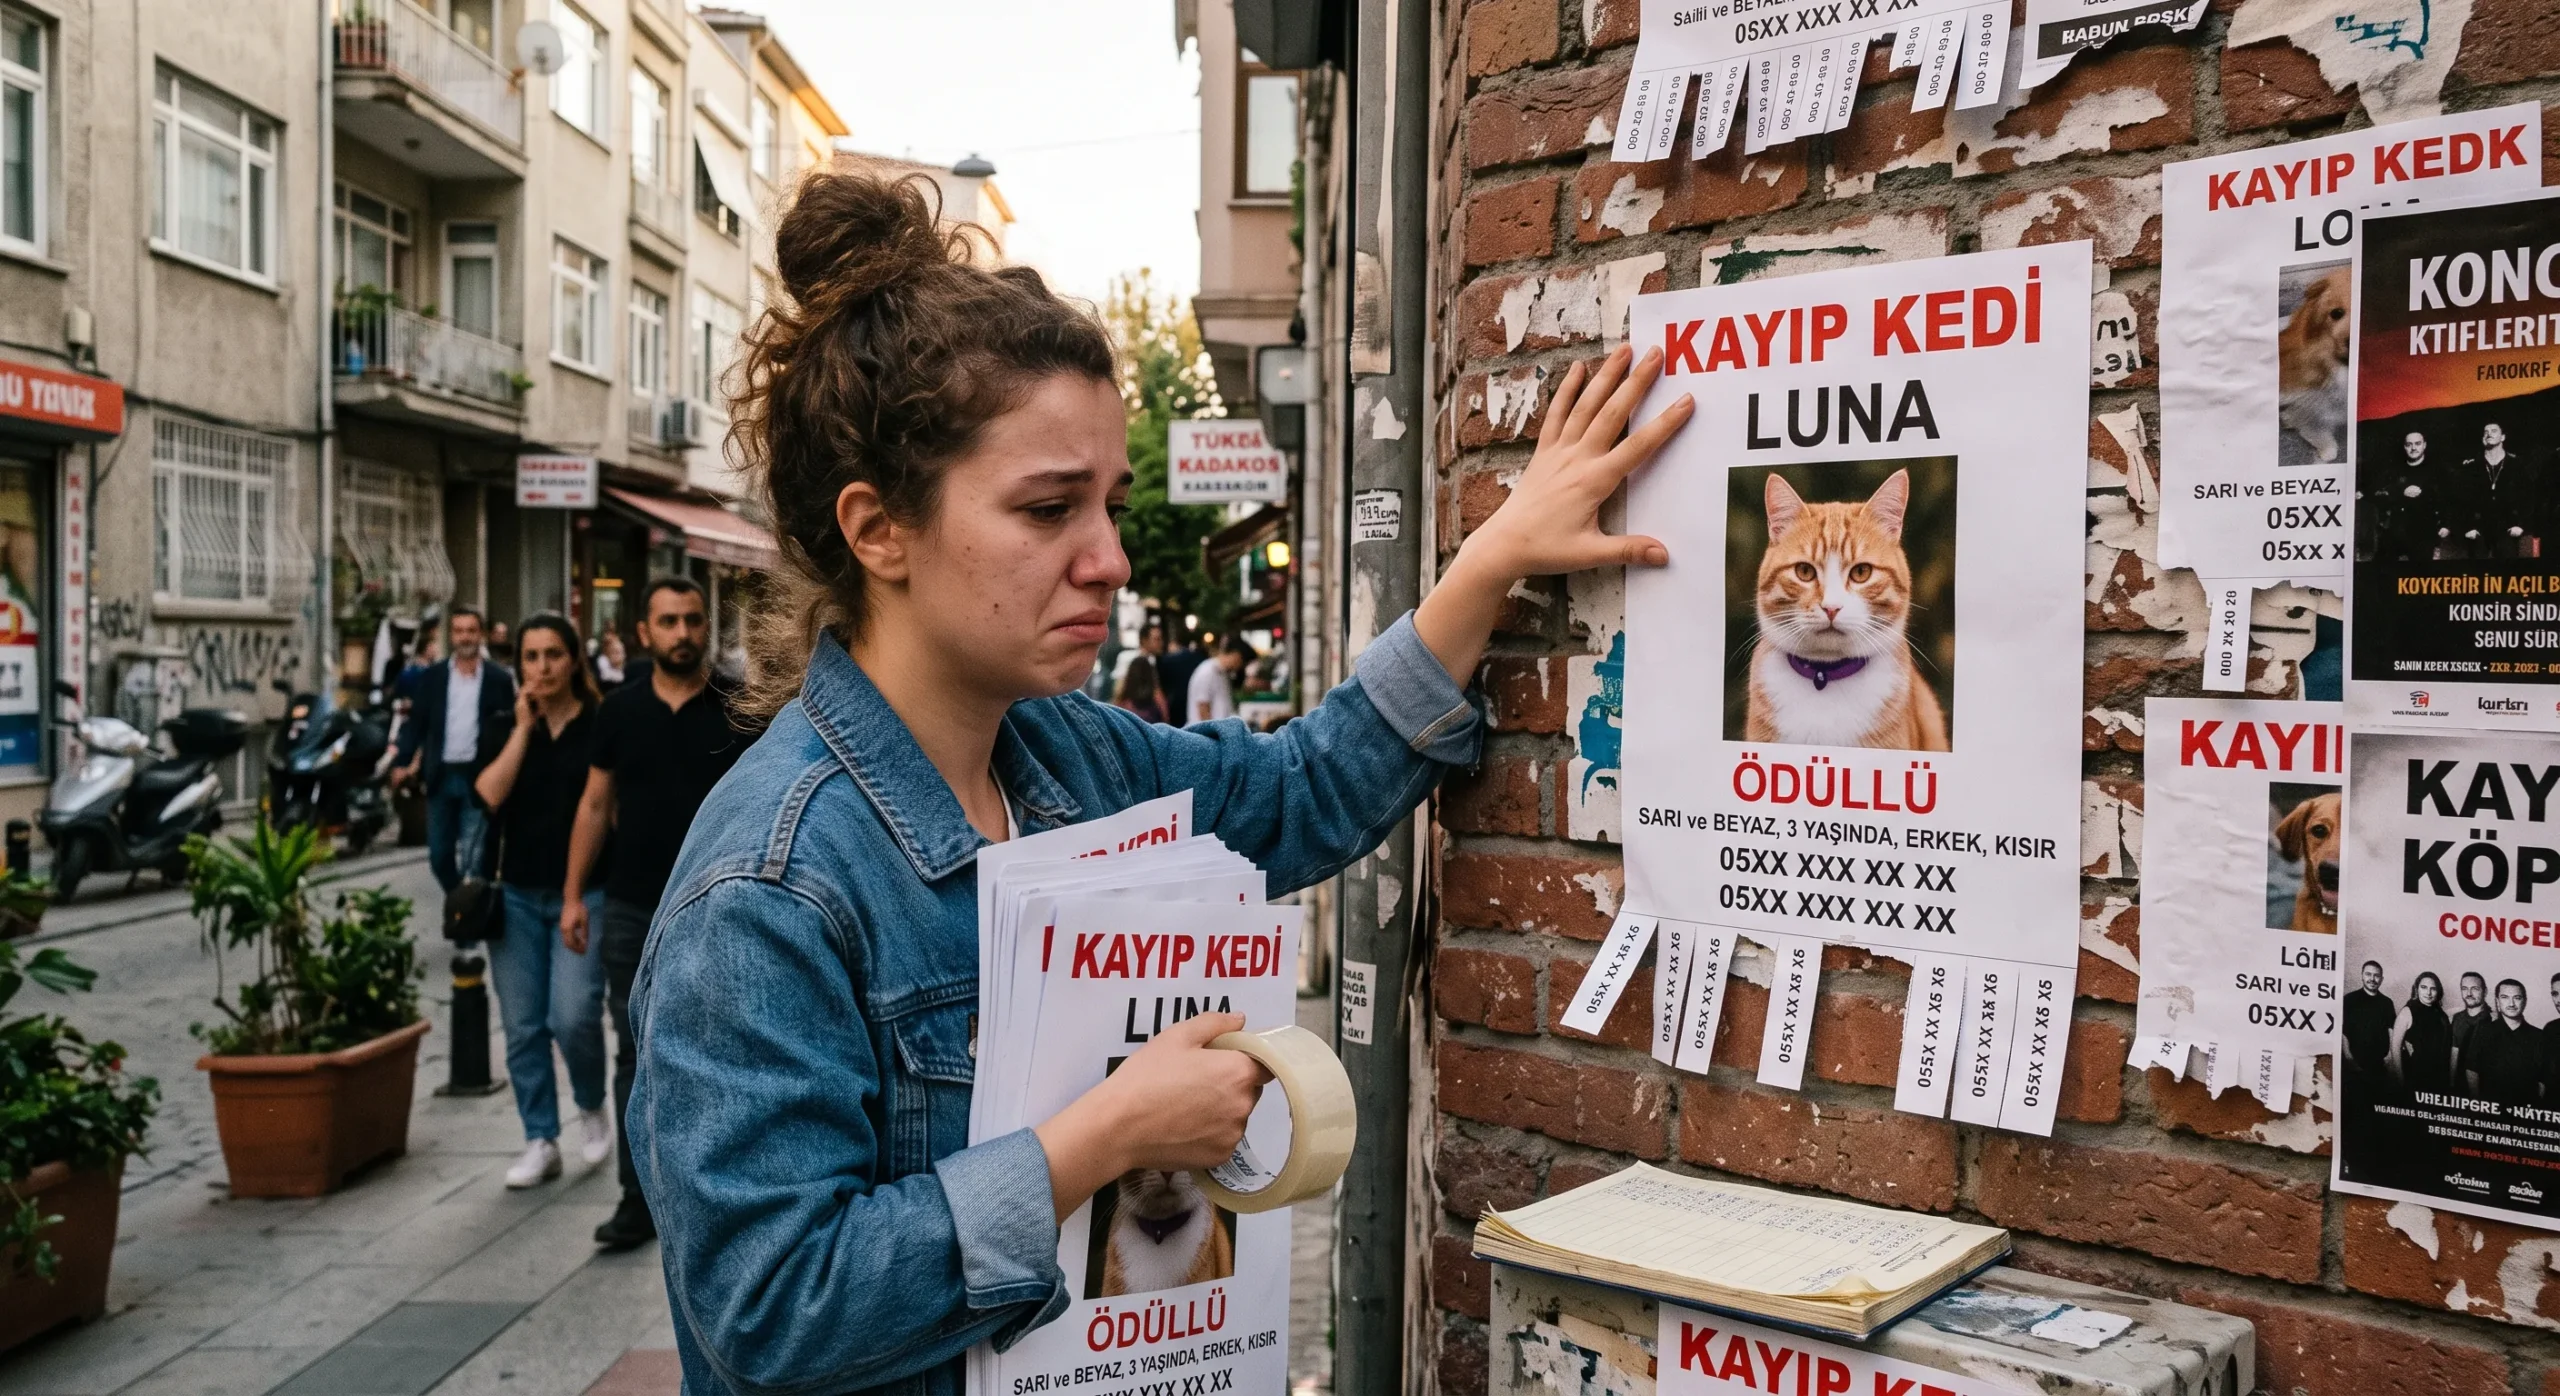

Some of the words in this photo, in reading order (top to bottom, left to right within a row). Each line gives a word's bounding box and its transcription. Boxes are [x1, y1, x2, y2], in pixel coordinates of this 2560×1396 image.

[1712, 5, 1728, 19] ve
[1795, 2, 1842, 32] XXX
[2208, 153, 2355, 212] KAYIP
[2374, 124, 2528, 184] KEDK
[1664, 303, 1849, 376] KAYIP
[1873, 265, 2042, 357] KEDİ
[1746, 379, 1941, 451] LUNA
[2194, 483, 2238, 499] SARI
[2244, 484, 2265, 497] ve
[2271, 478, 2341, 496] BEYAZ,
[2267, 504, 2342, 529] 05XX
[2507, 575, 2545, 597] AÇIL
[2524, 629, 2560, 648] SÜR
[2180, 719, 2343, 774] KAYI
[1733, 752, 1938, 815] ÖDÜLLÜ
[1638, 807, 1682, 829] SARI
[1687, 814, 1707, 830] ve
[1713, 812, 1781, 839] BEYAZ,
[1787, 818, 1797, 838] 3
[1803, 820, 1899, 850] YAŞINDA,
[1905, 828, 1987, 857] ERKEK,
[1995, 834, 2057, 860] KISIR
[1720, 846, 1789, 877] 05XX
[1796, 853, 1856, 883] XXX
[1864, 859, 1905, 888] XX
[1914, 864, 1957, 894] XX
[1719, 884, 1789, 916] 05XX
[1796, 892, 1856, 923] XXX
[1864, 900, 1905, 929] XX
[1914, 905, 1957, 935] XX
[2438, 912, 2560, 948] CONCE
[1071, 932, 1195, 979] KAYIP
[1203, 925, 1282, 979] KEDİ
[1604, 962, 1623, 980] XX
[1702, 985, 1714, 1006] XX
[2235, 973, 2282, 994] SARI
[2289, 983, 2311, 997] ve
[2317, 982, 2336, 1000] S
[1785, 997, 1799, 1019] XX
[2249, 1003, 2316, 1032] 05XX
[1925, 1017, 1940, 1041] XX
[1978, 1026, 1993, 1049] XX
[2031, 1033, 2048, 1057] XX
[1087, 1287, 1226, 1352] ÖDÜLLÜ
[1013, 1373, 1050, 1395] SARI
[1054, 1373, 1070, 1389] ve
[1074, 1361, 1125, 1385] BEYAZ,
[1129, 1360, 1137, 1376] 3
[1140, 1348, 1199, 1375] YAŞINDA,
[1202, 1337, 1245, 1362] ERKEK,
[1248, 1329, 1277, 1351] KISIR
[1680, 1321, 1851, 1396] KAYIP
[1183, 1369, 1208, 1396] XX
[1210, 1368, 1233, 1392] XX
